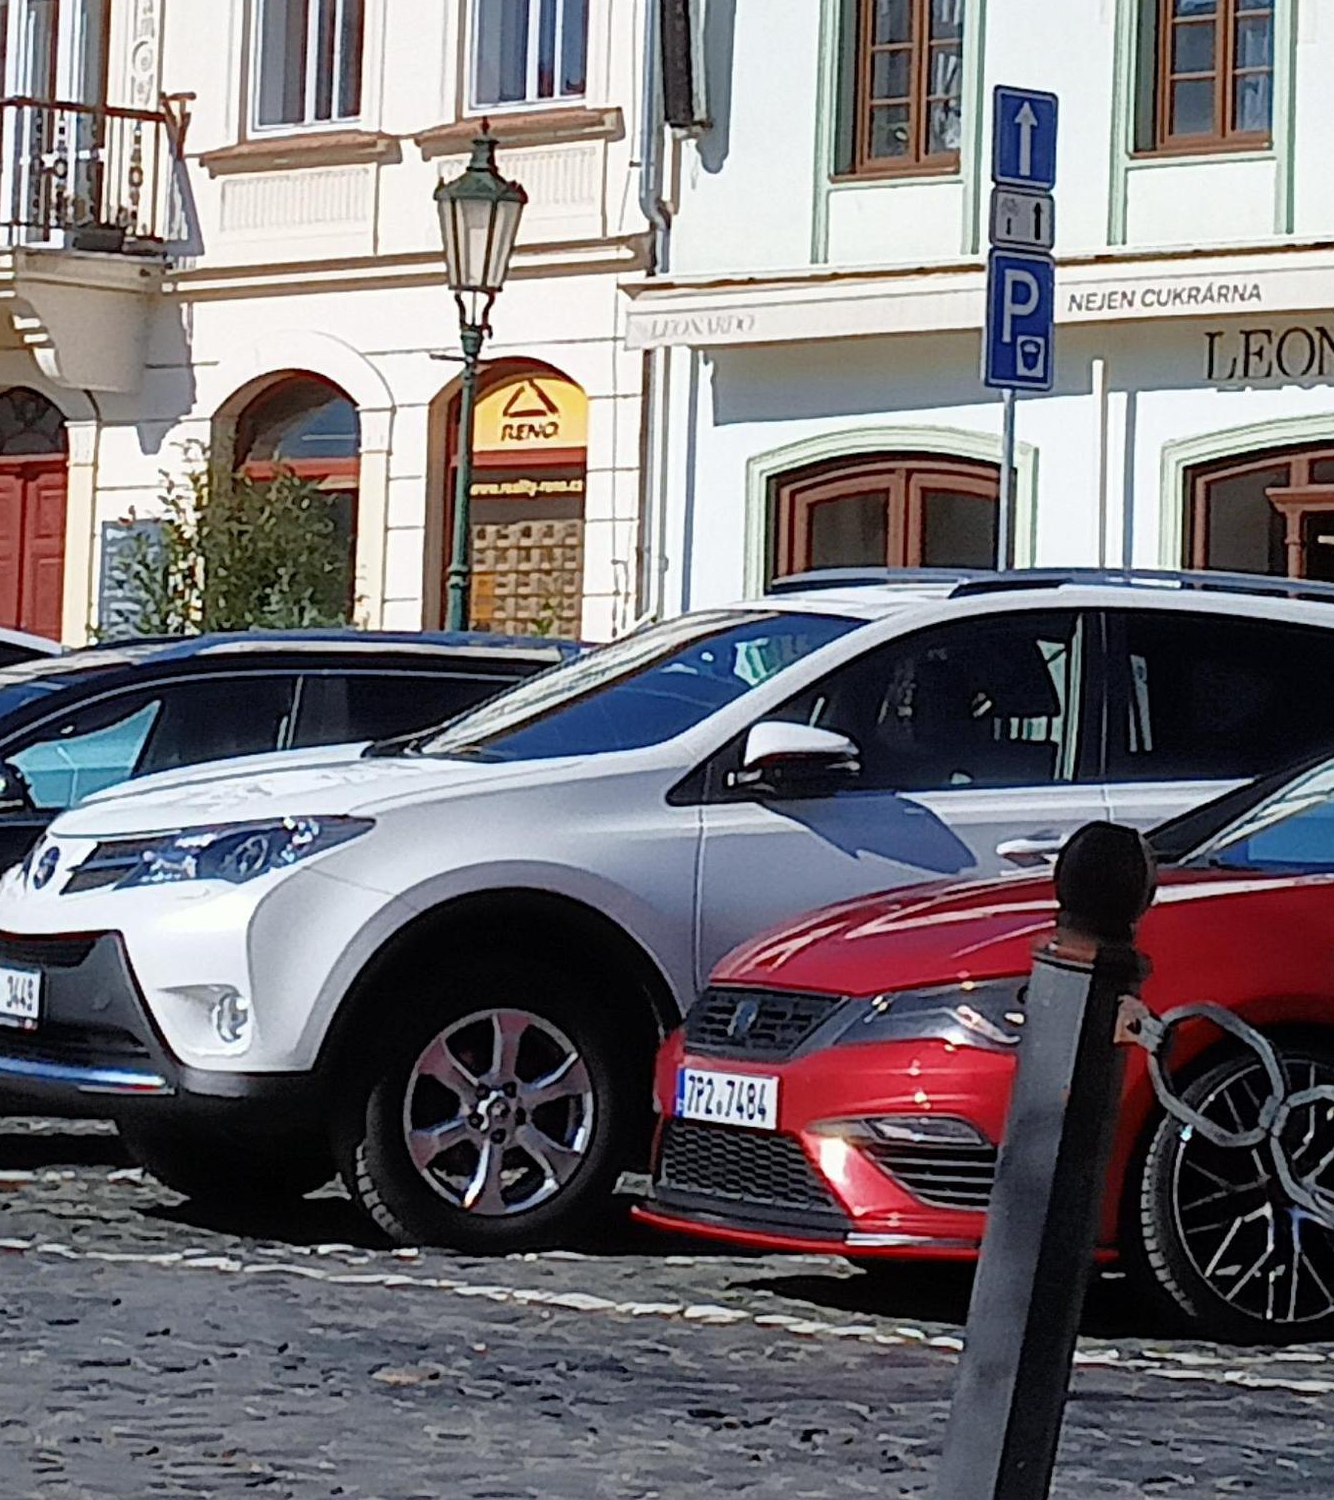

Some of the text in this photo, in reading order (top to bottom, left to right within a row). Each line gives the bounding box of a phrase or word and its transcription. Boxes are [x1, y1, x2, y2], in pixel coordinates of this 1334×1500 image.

[1002, 268, 1039, 343] P
[1067, 282, 1262, 312] NEJEN CUKRÁRNA
[650, 314, 756, 339] LEONARDO
[501, 423, 558, 441] RENO
[688, 1074, 766, 1122] 7P2 7484
